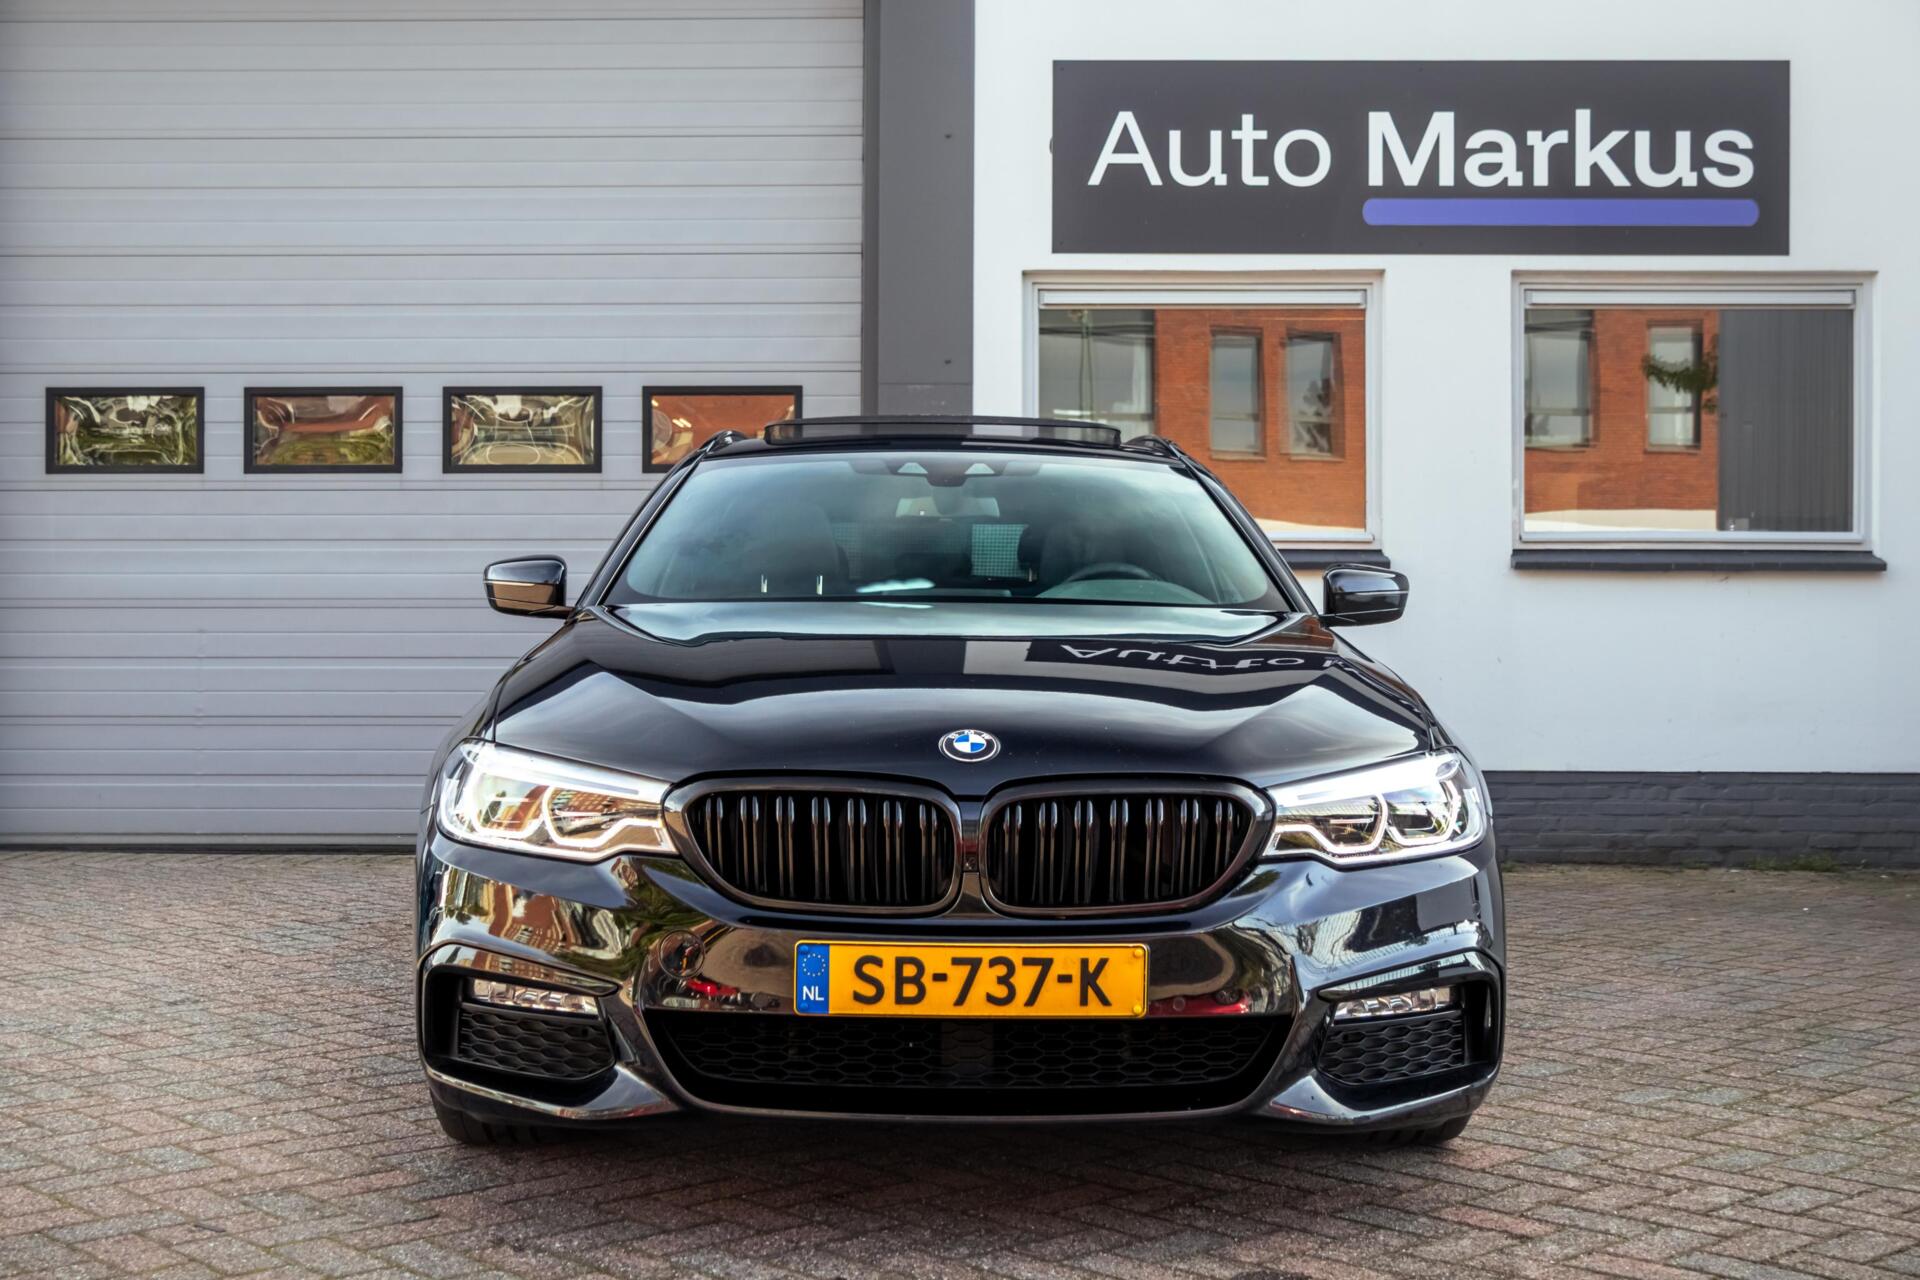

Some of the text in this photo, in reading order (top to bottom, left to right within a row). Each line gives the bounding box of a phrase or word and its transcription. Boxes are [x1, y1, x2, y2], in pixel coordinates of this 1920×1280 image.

[1087, 108, 1754, 188] Auto Markus
[802, 985, 825, 1001] NL
[852, 955, 1112, 1007] SB-737-K
